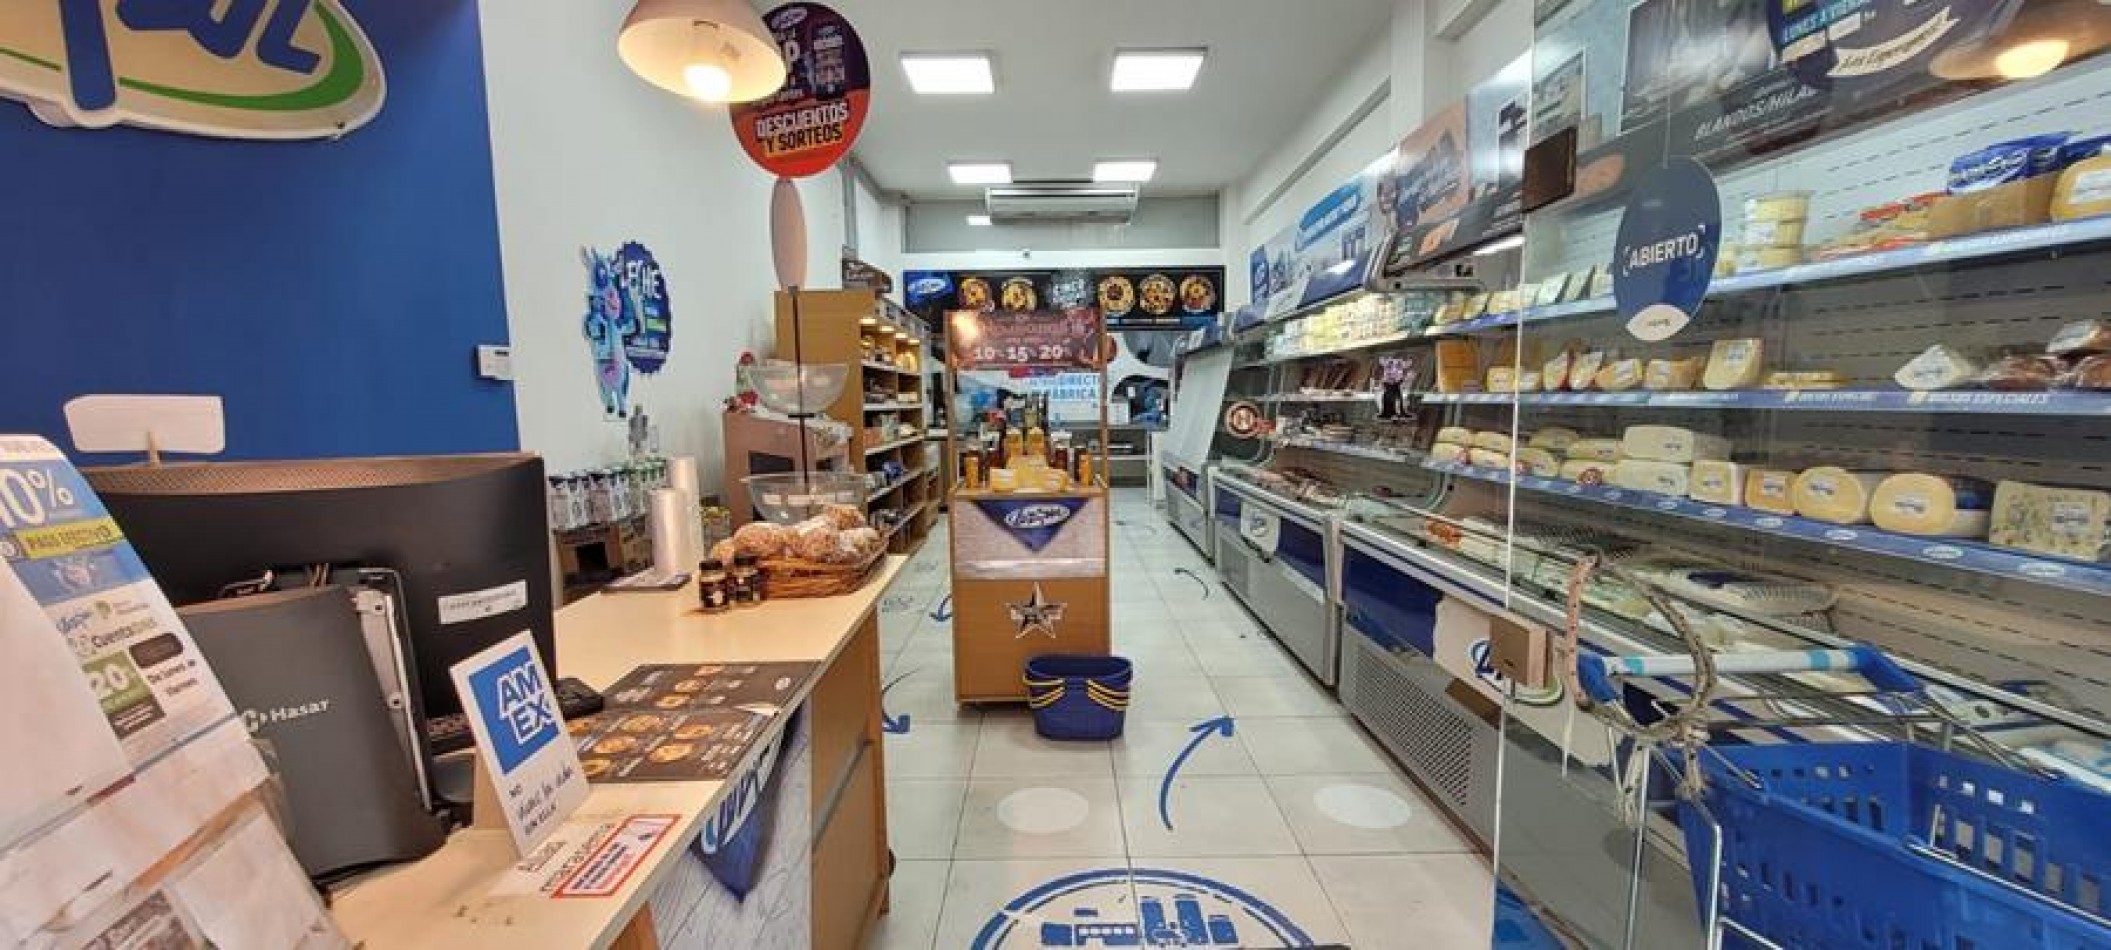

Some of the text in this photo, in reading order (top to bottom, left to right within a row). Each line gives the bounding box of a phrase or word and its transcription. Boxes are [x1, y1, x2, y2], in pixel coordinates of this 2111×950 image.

[756, 102, 848, 139] DESCUENTOS
[778, 122, 844, 152] SORTEOS
[1629, 231, 1699, 268] ABIERTO
[497, 661, 544, 720] AM
[268, 698, 329, 723] Hasar
[509, 691, 560, 745] EX
